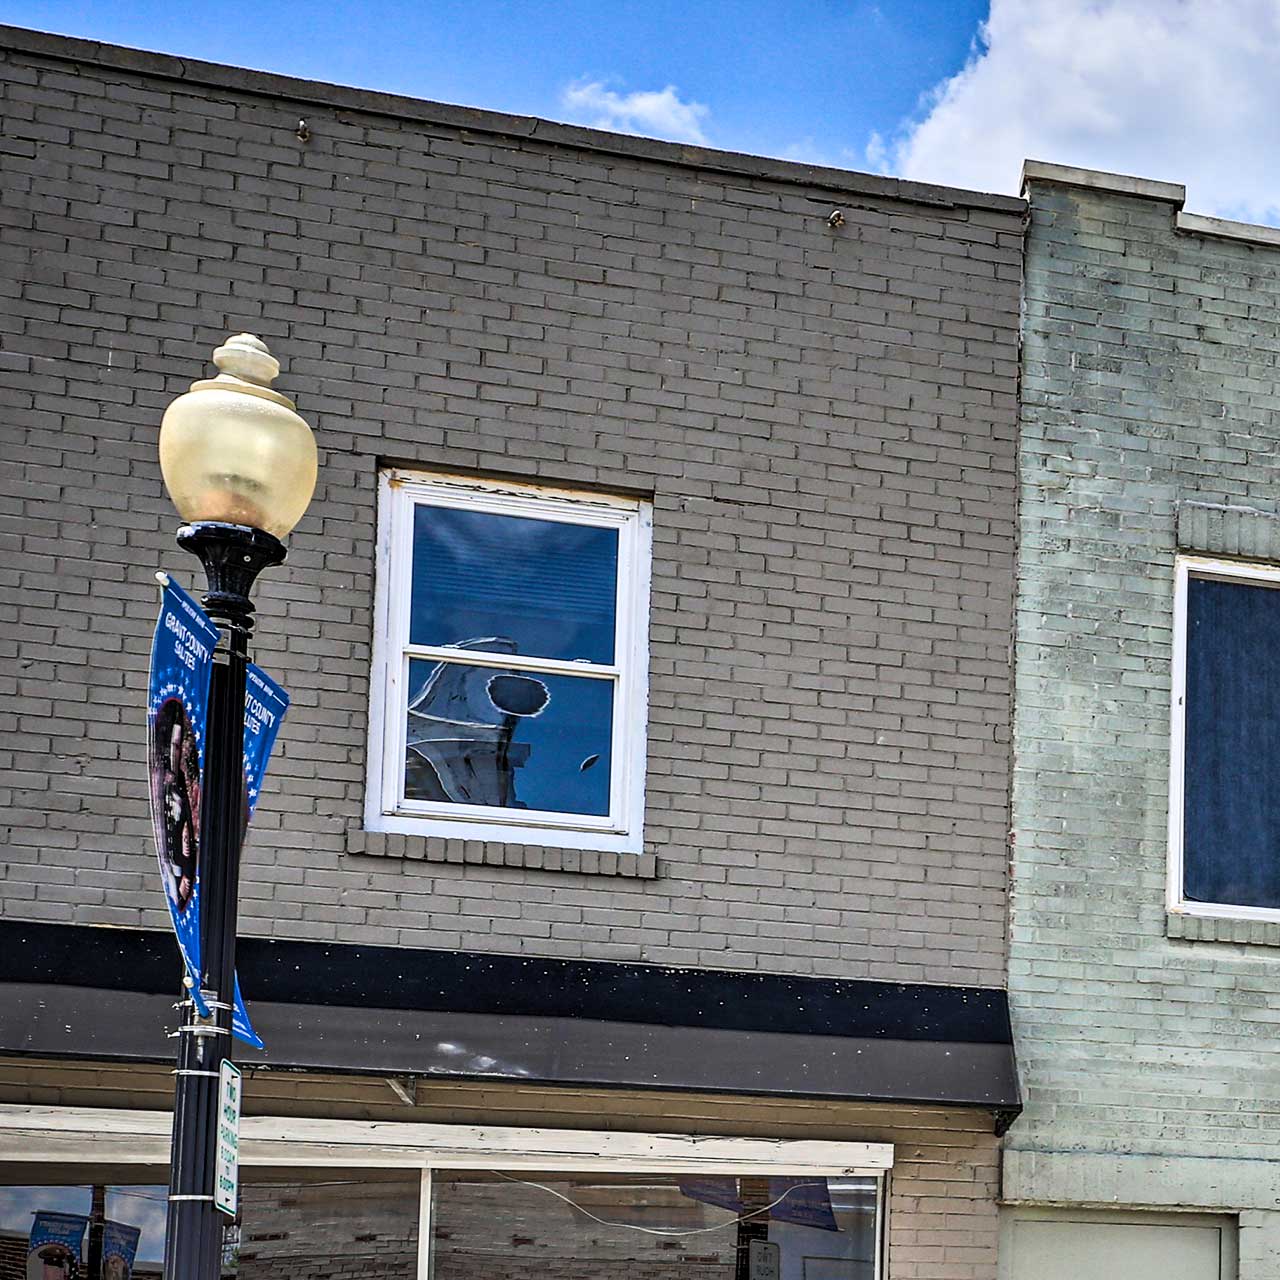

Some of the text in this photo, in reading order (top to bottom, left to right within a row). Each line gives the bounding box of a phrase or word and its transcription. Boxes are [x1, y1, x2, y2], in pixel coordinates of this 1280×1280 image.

[165, 612, 187, 642] GRANT
[185, 631, 208, 664] COUNTY
[250, 699, 276, 728] COUNTY
